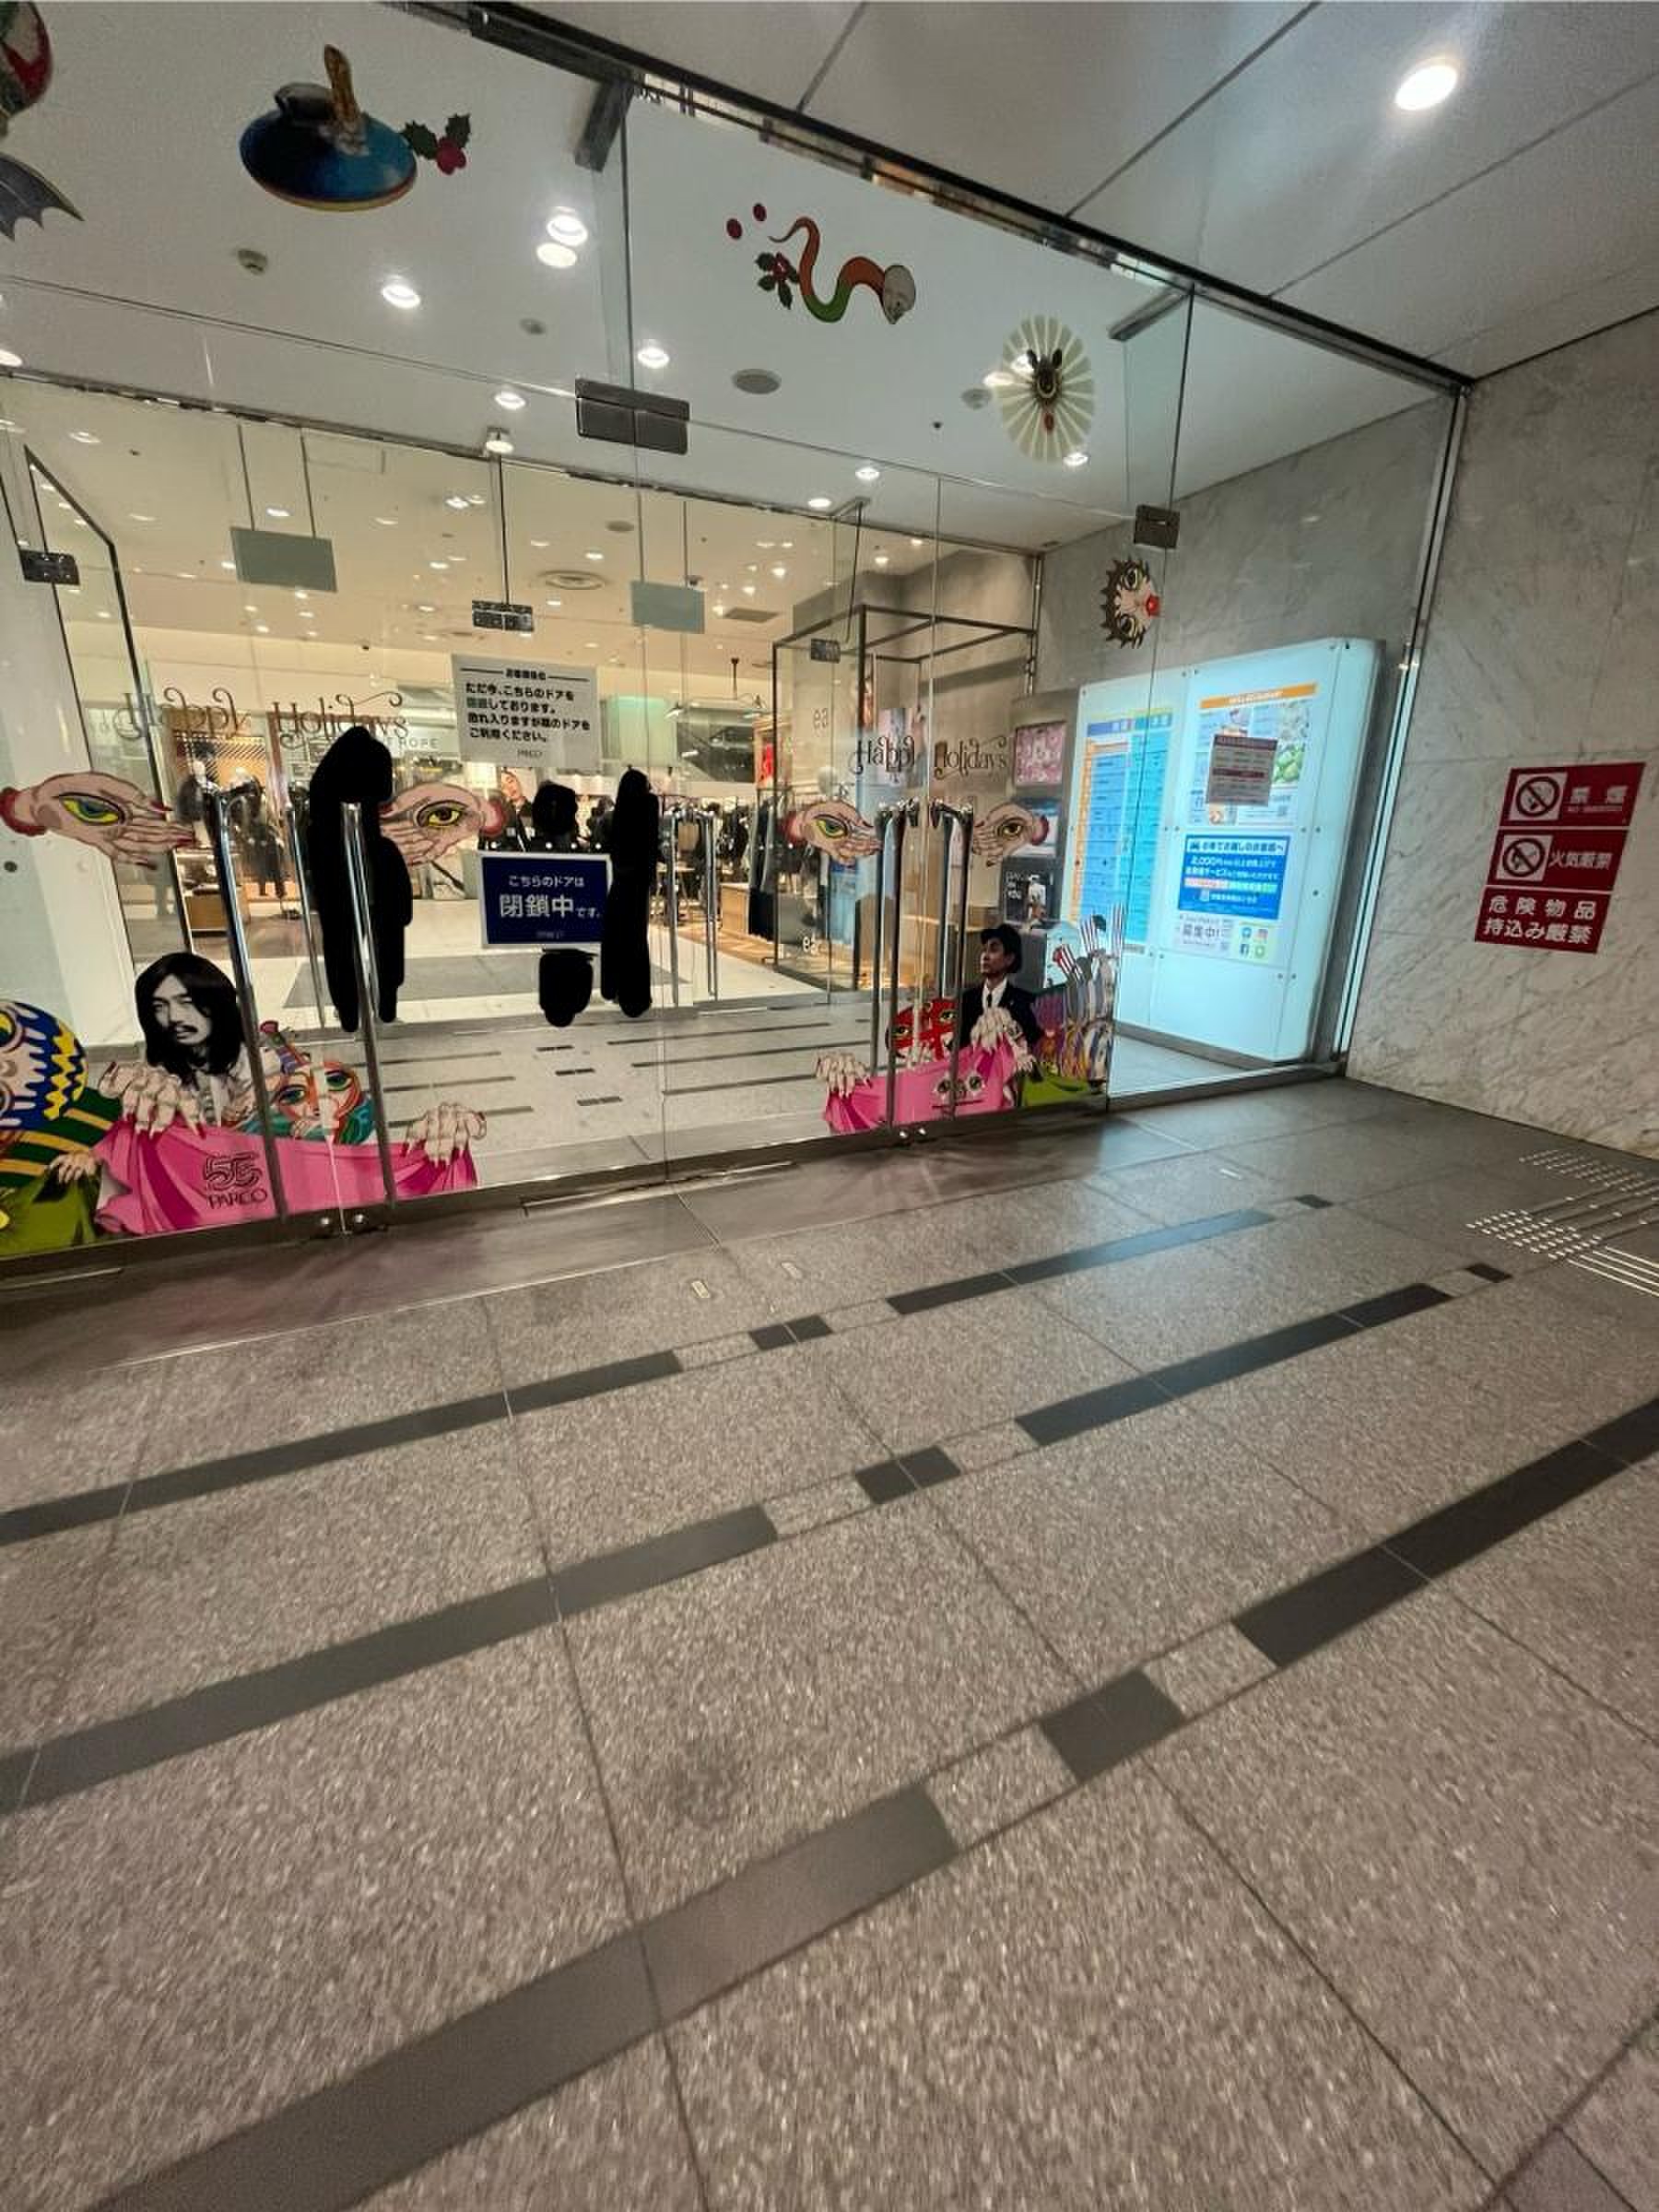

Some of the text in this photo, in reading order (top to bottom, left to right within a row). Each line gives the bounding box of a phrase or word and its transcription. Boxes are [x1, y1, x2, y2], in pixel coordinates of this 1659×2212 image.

[508, 875, 585, 888] こちらのドアは
[1482, 918, 1594, 945] 持込み厳禁
[207, 1188, 267, 1209] PARCO
